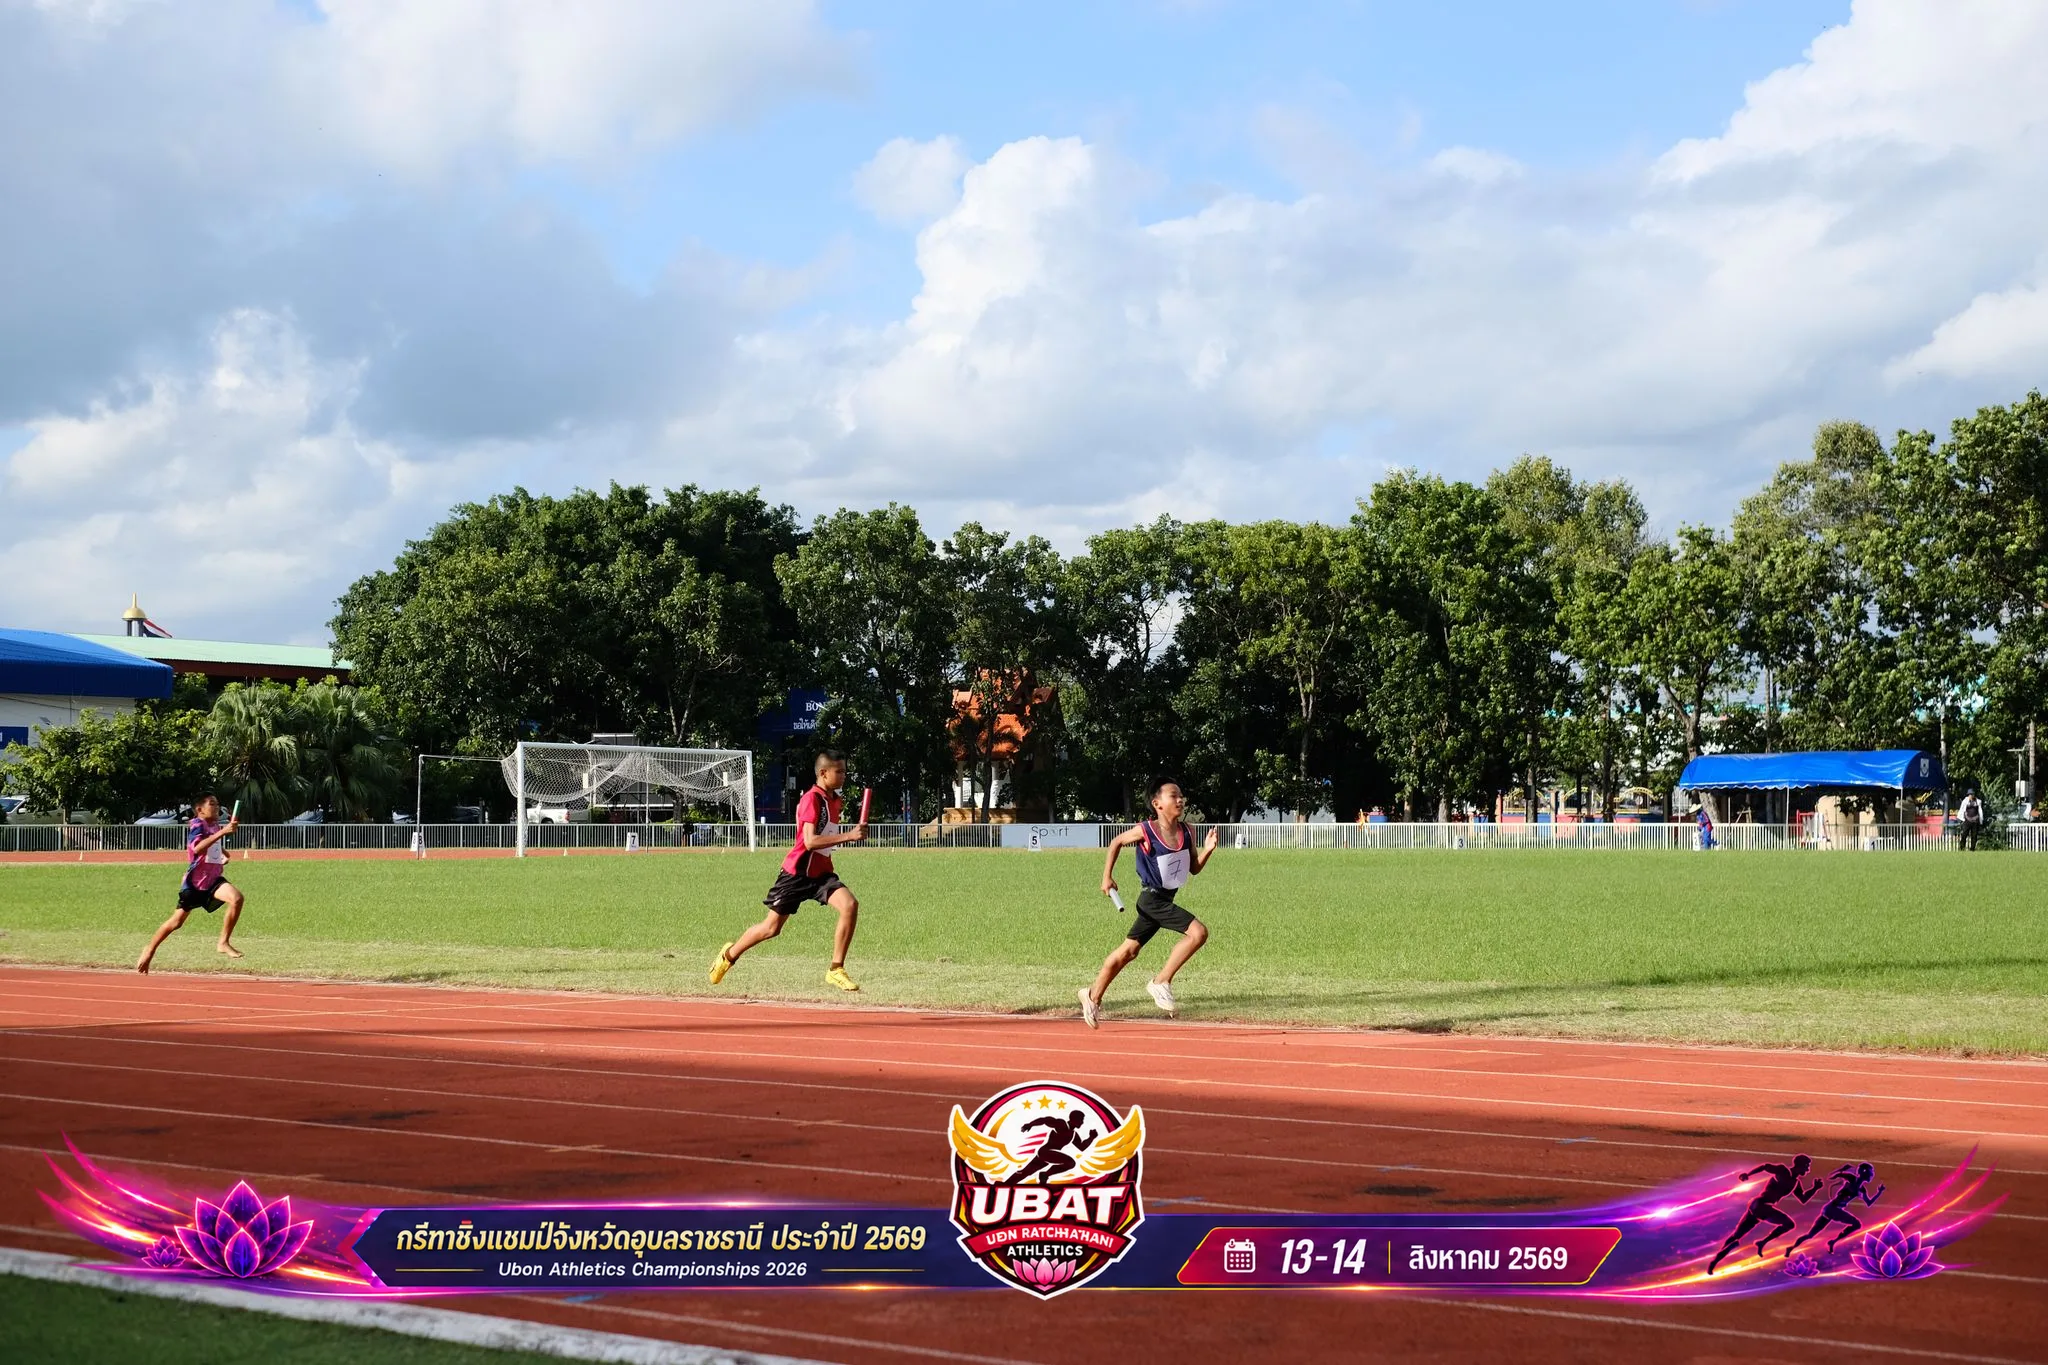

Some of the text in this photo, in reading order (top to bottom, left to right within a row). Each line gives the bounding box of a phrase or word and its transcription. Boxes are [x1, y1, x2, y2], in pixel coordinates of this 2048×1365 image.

[631, 835, 636, 845] 7
[1032, 835, 1038, 845] 5
[1458, 838, 1464, 848] 3
